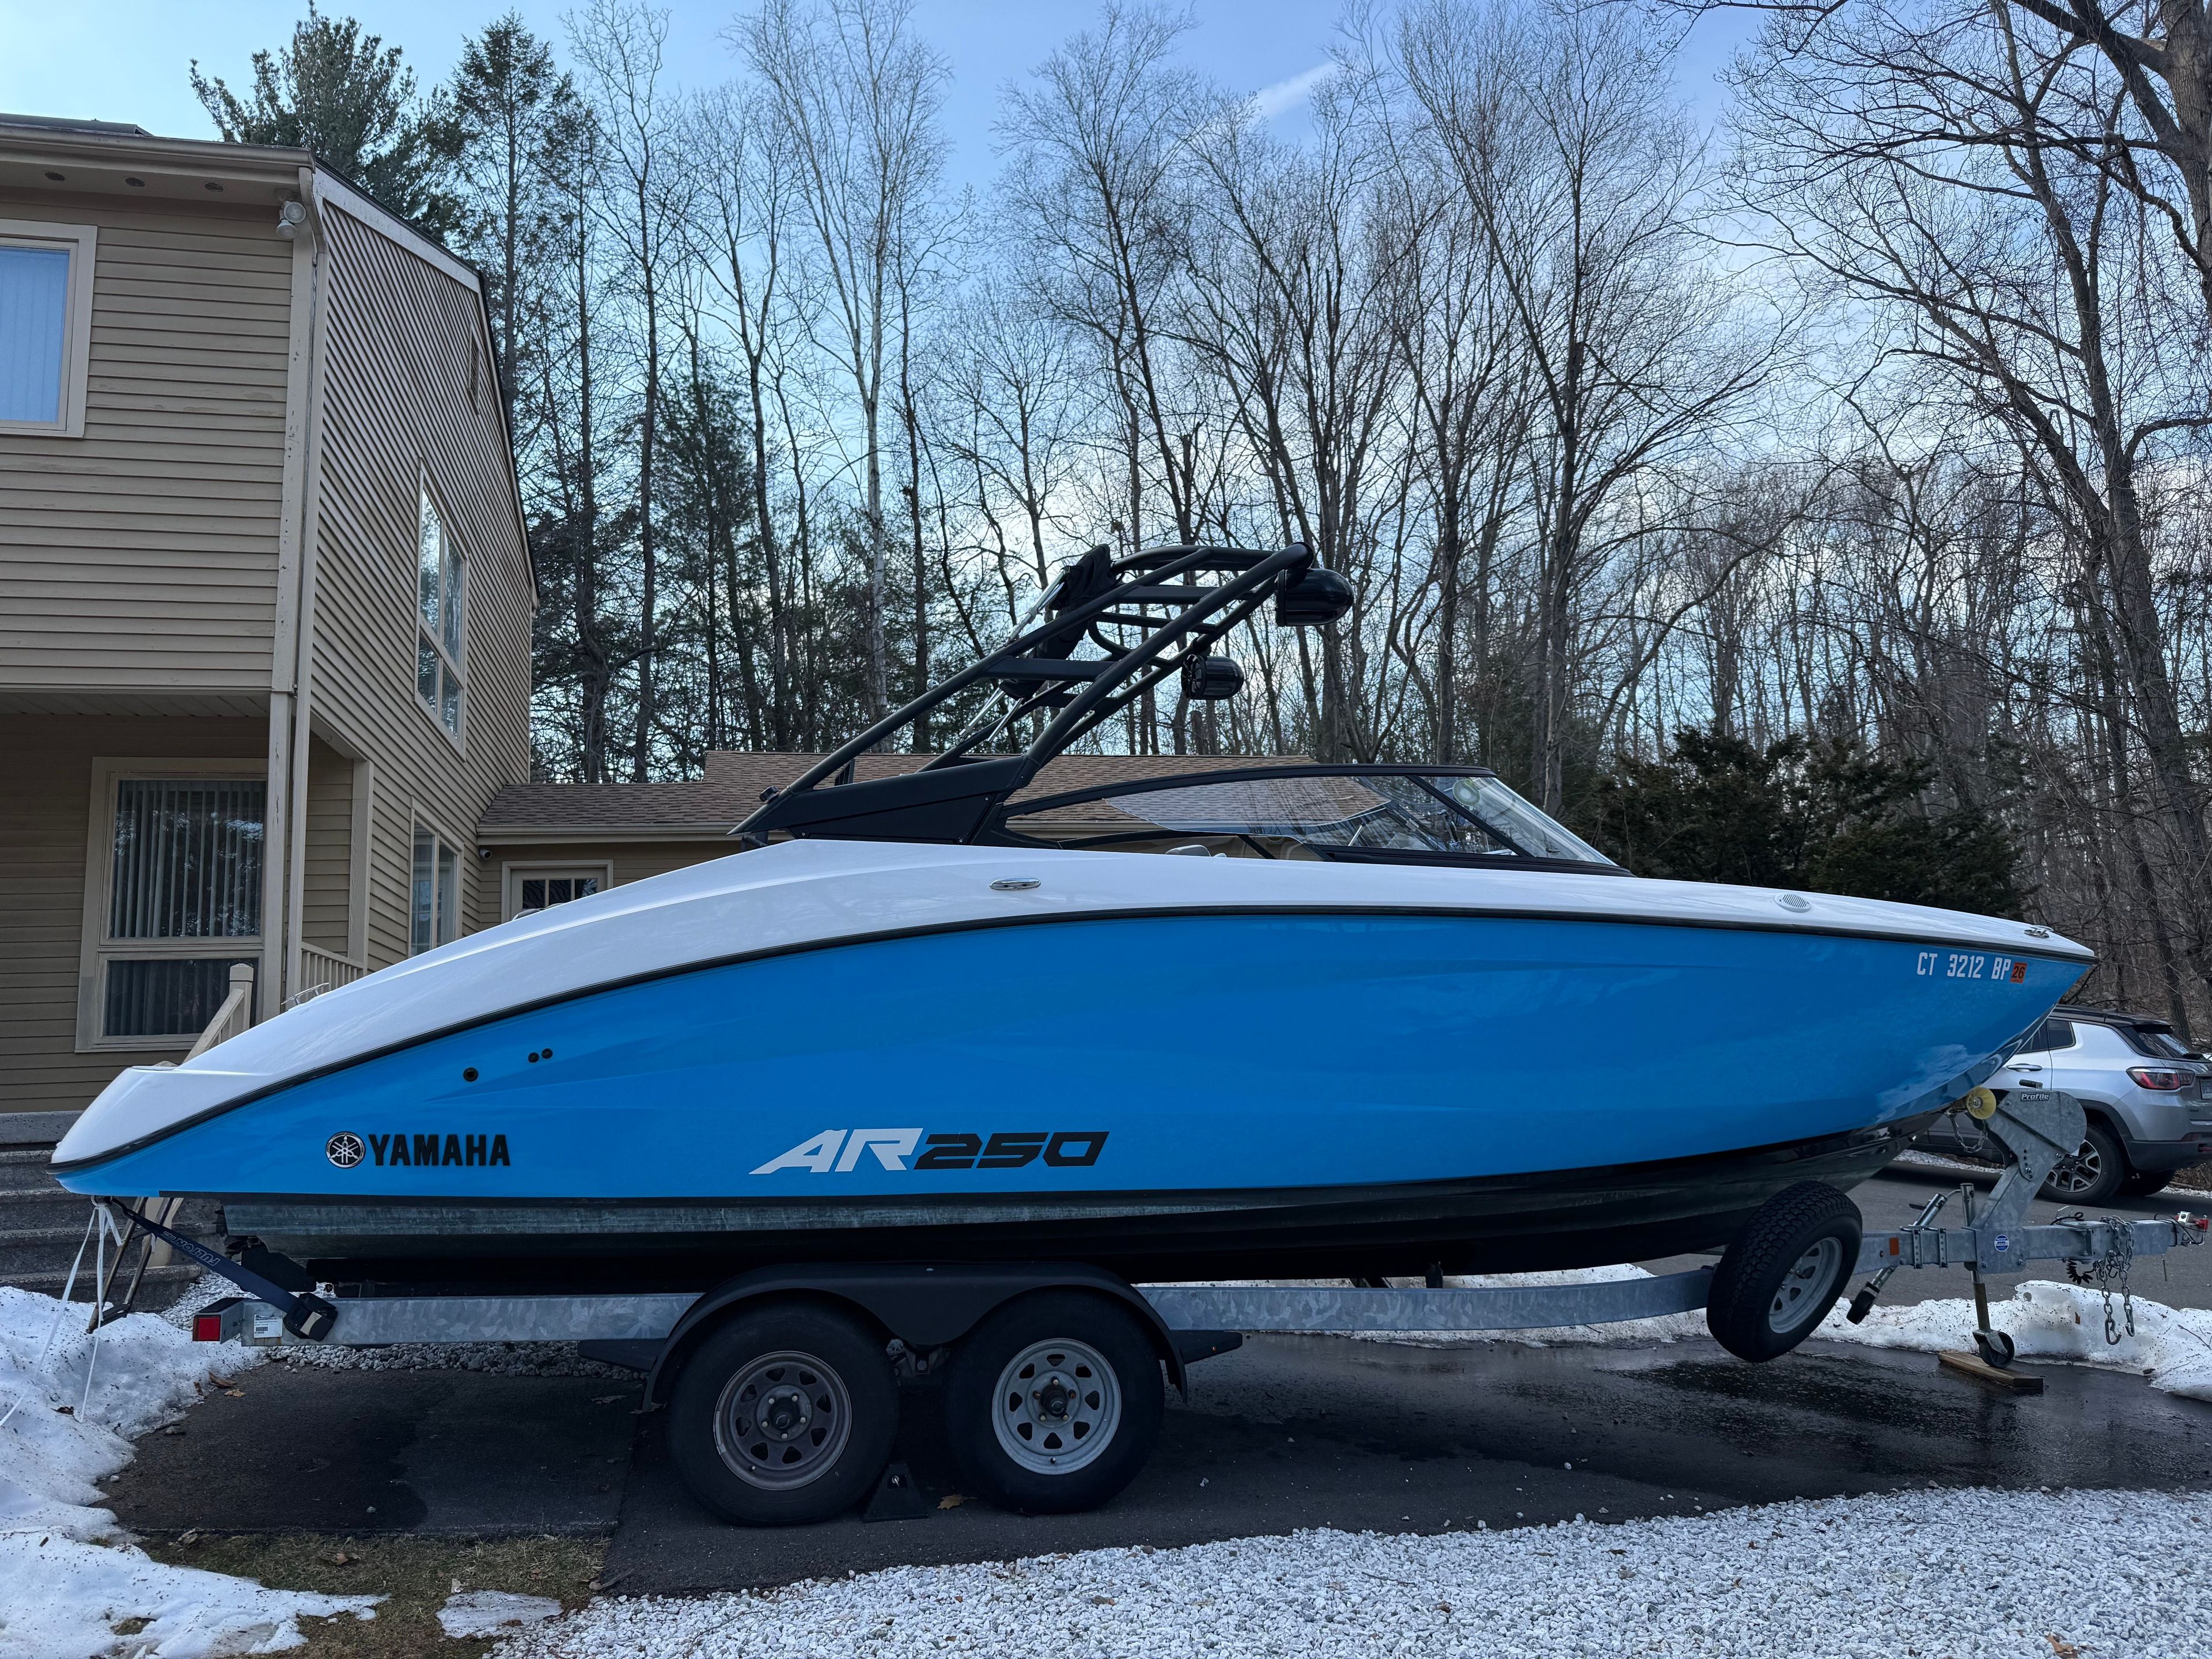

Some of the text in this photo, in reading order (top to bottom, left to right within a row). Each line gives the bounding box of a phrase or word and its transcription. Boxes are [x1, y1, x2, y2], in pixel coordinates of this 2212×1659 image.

[1917, 952, 2012, 980] CT 3212 BP
[2012, 965, 2025, 979] 26
[368, 1134, 511, 1166] YAMAHA
[172, 1238, 221, 1266] FULTON
